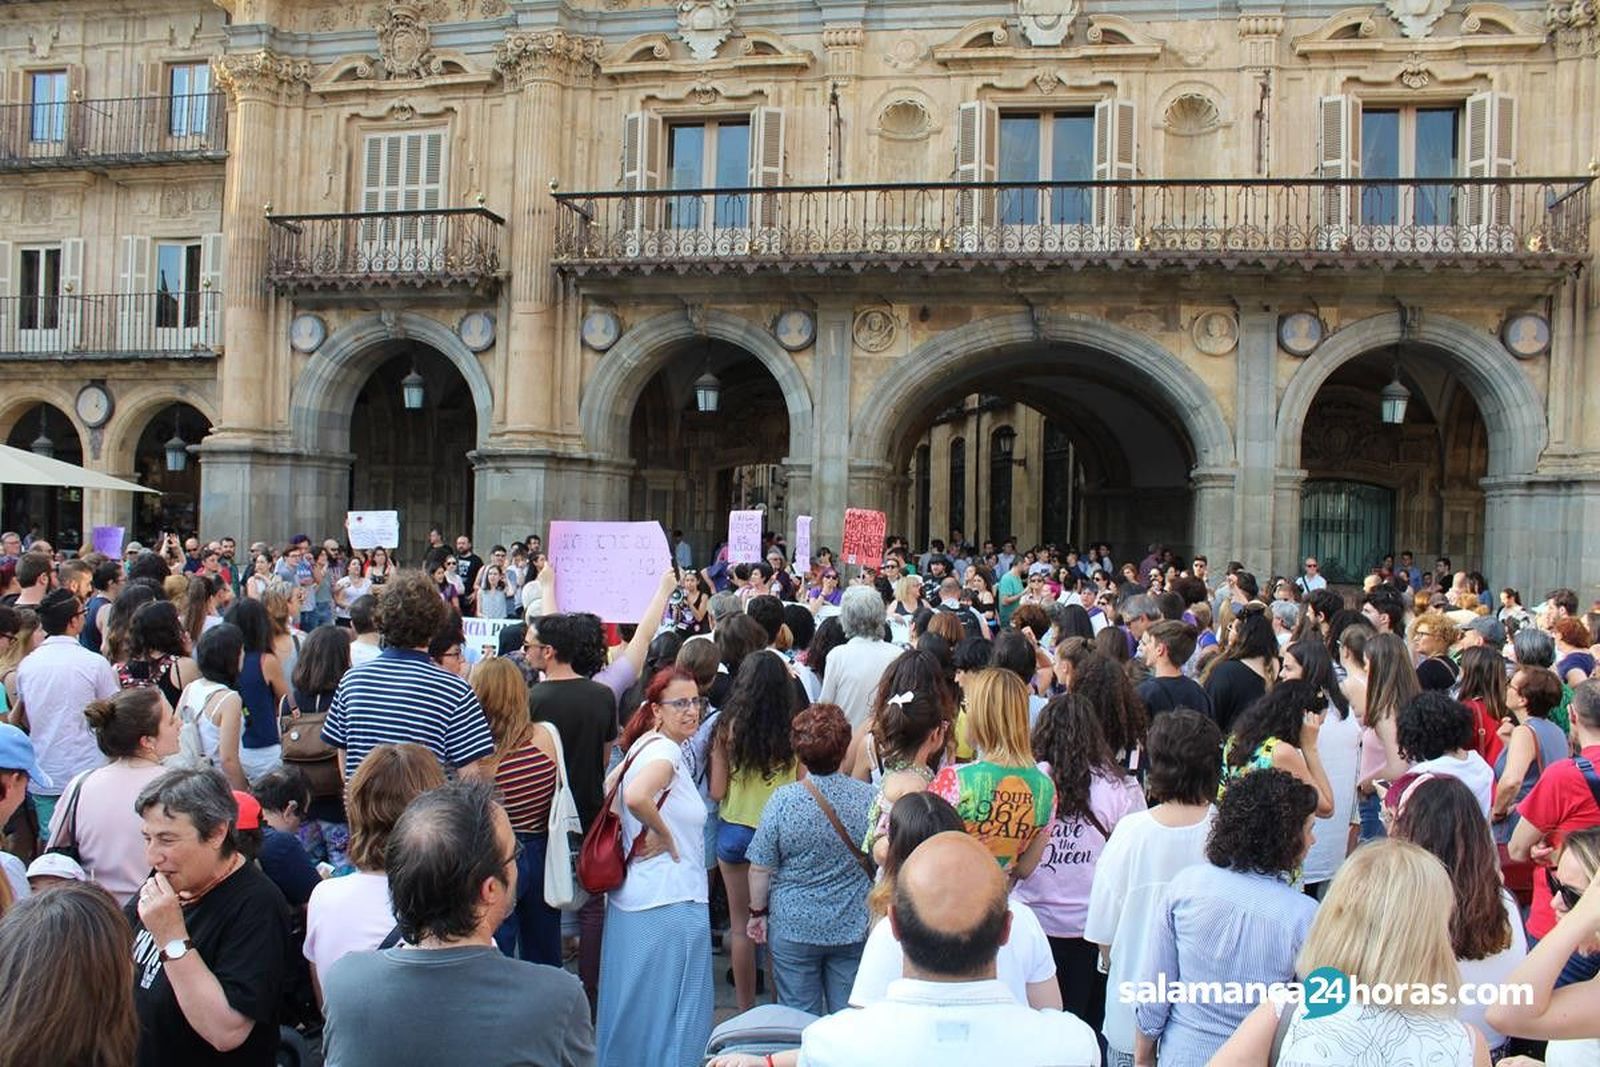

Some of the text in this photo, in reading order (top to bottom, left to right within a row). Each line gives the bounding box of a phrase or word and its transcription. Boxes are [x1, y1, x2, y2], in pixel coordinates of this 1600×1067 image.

[990, 789, 1034, 804] TOUR
[1050, 823, 1085, 839] ave
[1058, 839, 1076, 851] the
[1040, 844, 1092, 874] Queen
